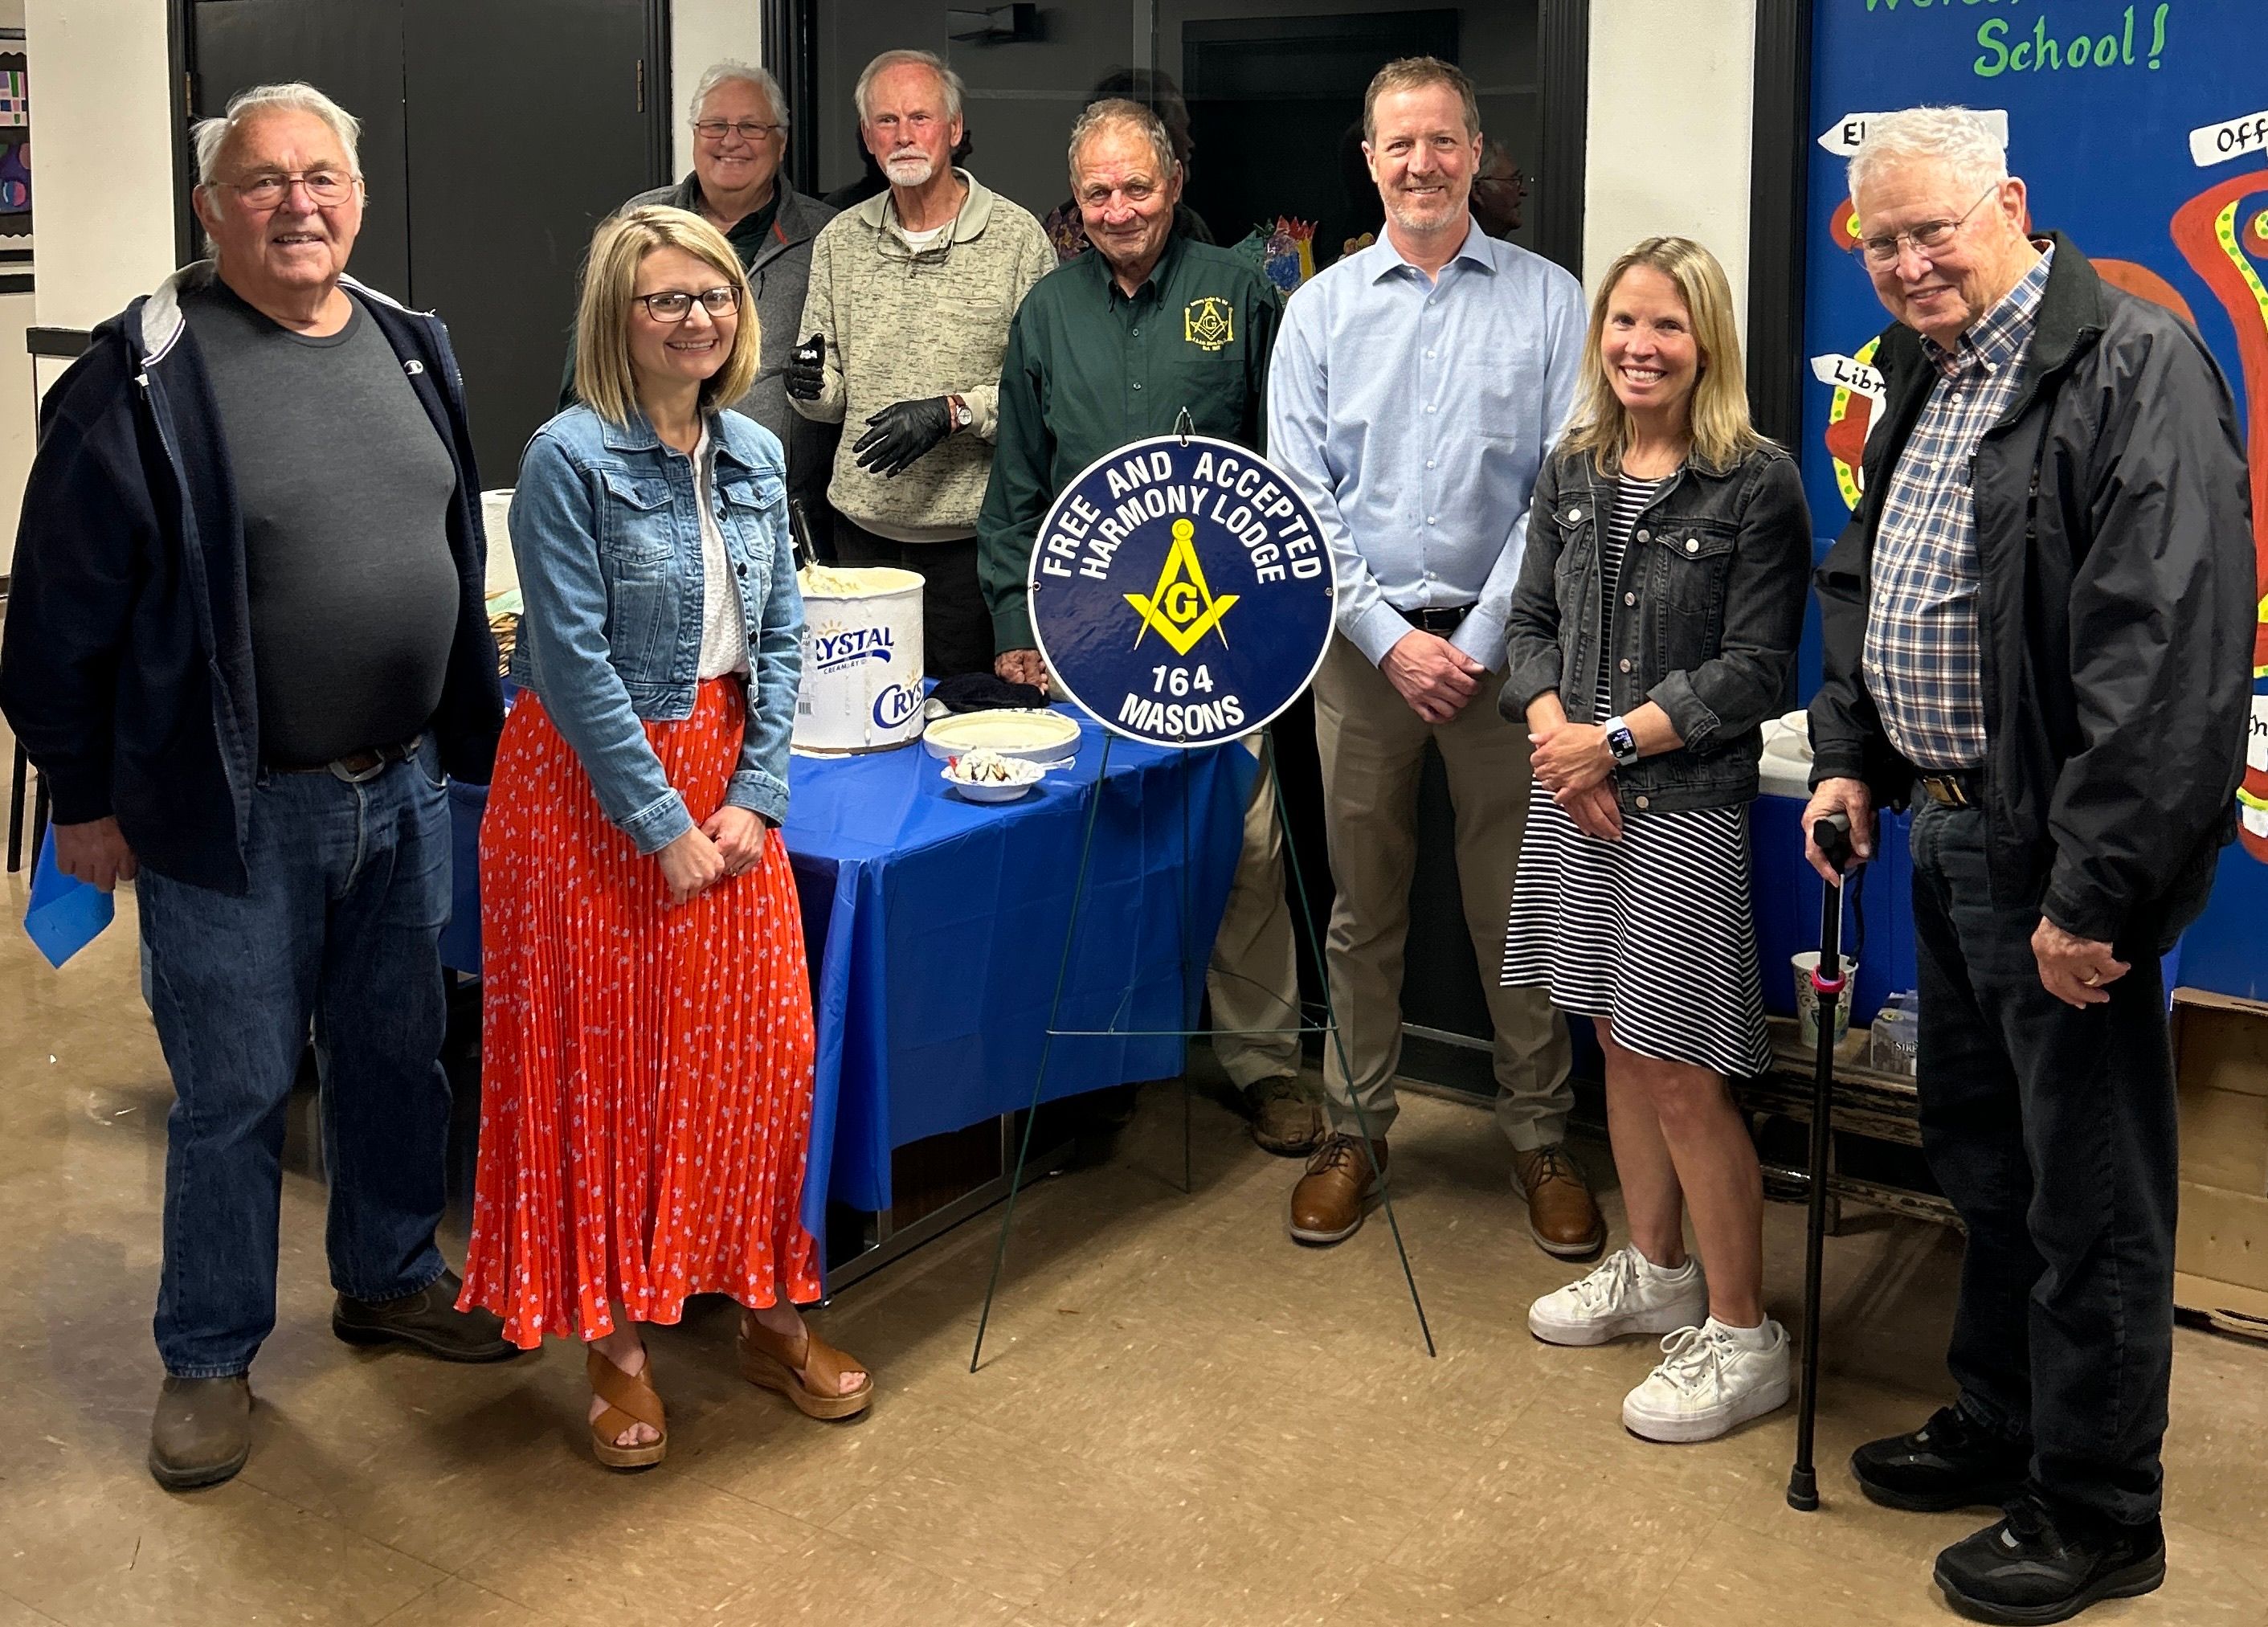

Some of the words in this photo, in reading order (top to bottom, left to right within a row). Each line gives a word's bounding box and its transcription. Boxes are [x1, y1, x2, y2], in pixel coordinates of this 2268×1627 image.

[1042, 494, 1101, 578] FREE
[1105, 451, 1173, 500] AND
[1192, 452, 1322, 579] ACCEPTED
[1079, 484, 1209, 580] HARMONY
[1211, 494, 1286, 585] LODGE
[1164, 582, 1199, 624] G
[1152, 664, 1214, 697] 164
[1118, 692, 1244, 736] MASONS
